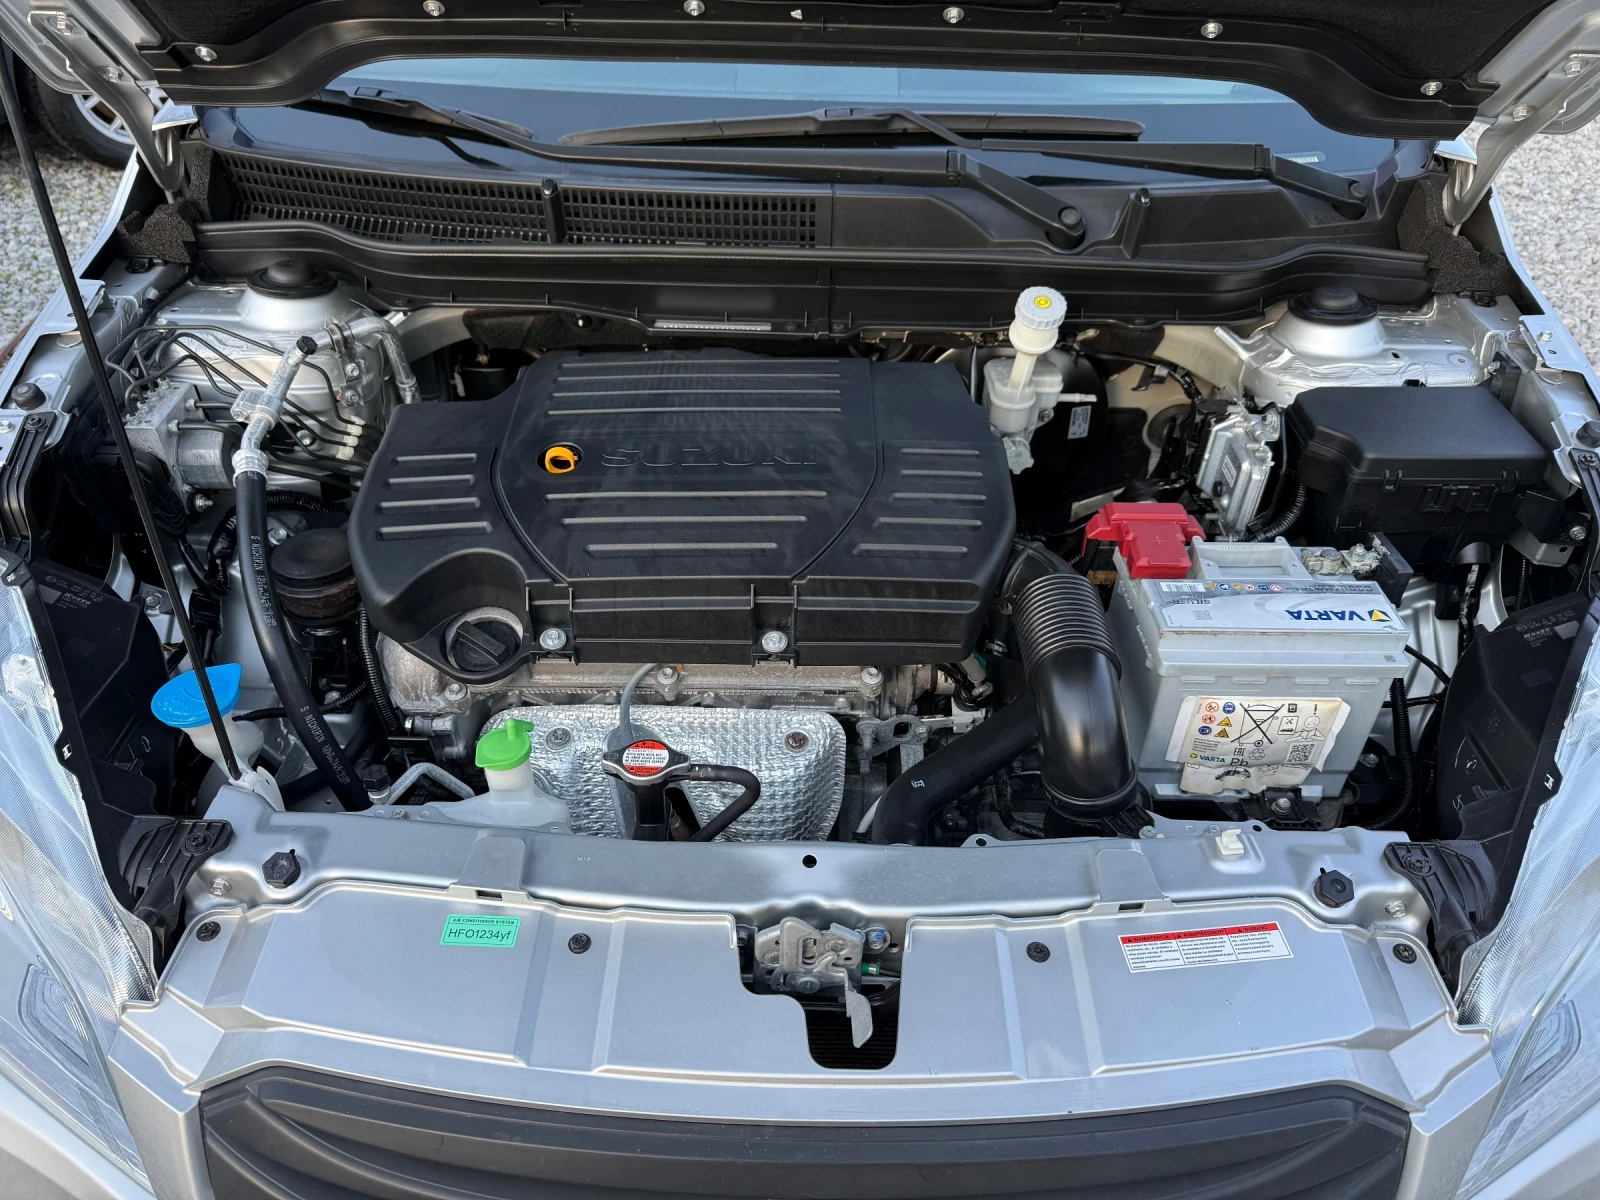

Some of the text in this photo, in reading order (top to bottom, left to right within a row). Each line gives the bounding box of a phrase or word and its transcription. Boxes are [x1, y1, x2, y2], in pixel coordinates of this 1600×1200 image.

[601, 446, 817, 467] SUZUKI
[1285, 609, 1366, 621] VARTA
[1199, 754, 1226, 764] VARTA
[1229, 757, 1249, 767] Pb
[448, 928, 512, 942] HFO1234yf
